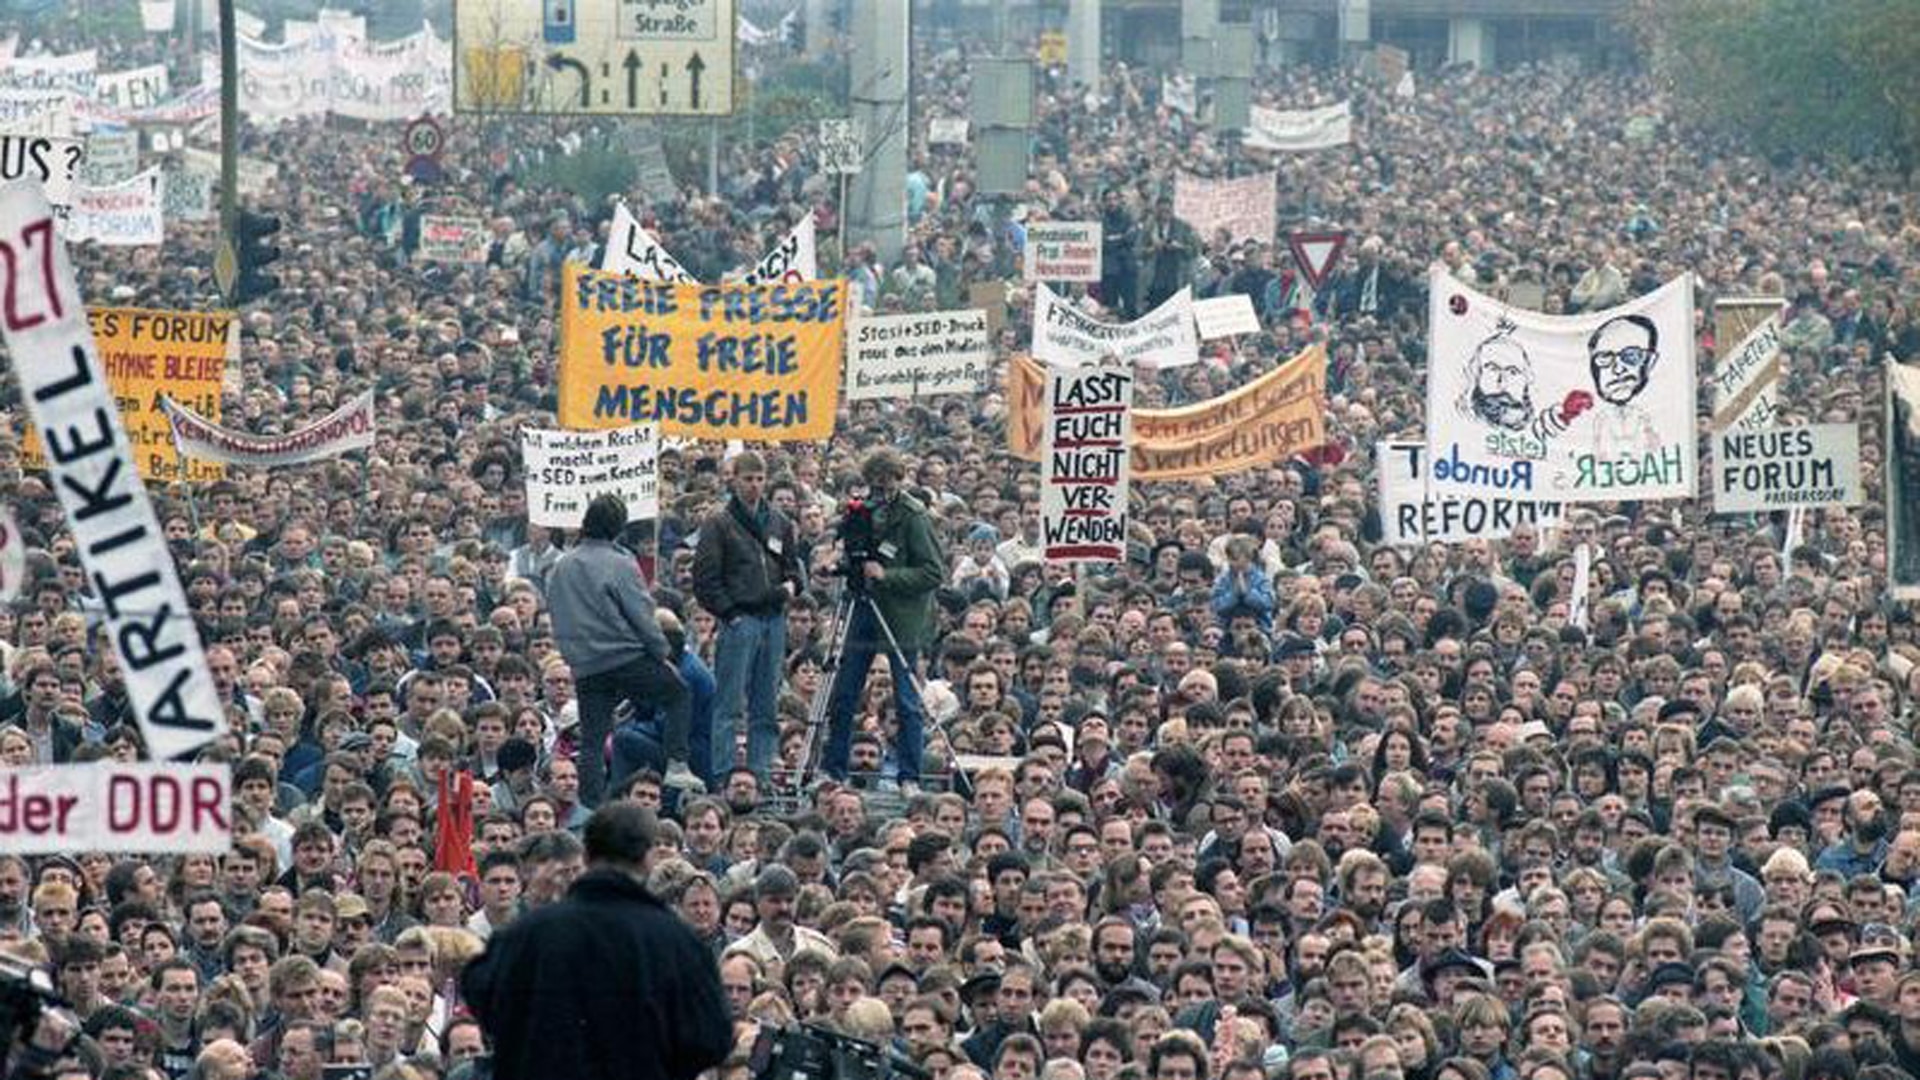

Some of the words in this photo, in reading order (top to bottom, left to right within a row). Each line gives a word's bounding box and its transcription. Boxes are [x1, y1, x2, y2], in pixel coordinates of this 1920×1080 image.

[635, 14, 697, 33] Straße
[413, 130, 436, 151] 60
[0, 218, 63, 331] 27
[577, 274, 678, 315] FREIE
[700, 284, 839, 324] PRESSE
[132, 315, 230, 343] FORUM
[601, 324, 671, 368] FÜR
[697, 332, 799, 375] FREIE
[1715, 322, 1781, 394] TAPETEN
[594, 384, 808, 427] MENSCHEN
[1054, 373, 1130, 407] LASST
[608, 427, 651, 448] Recht
[1056, 414, 1121, 443] EUCH
[1723, 430, 1813, 460] NEUES
[542, 468, 576, 485] SED
[1053, 448, 1125, 478] NICHT
[1724, 458, 1834, 492] FORUM
[1062, 486, 1115, 508] VER-
[36, 344, 215, 731] ARTIKEL
[1044, 513, 1125, 545] WENDEN
[108, 774, 229, 836] DDR
